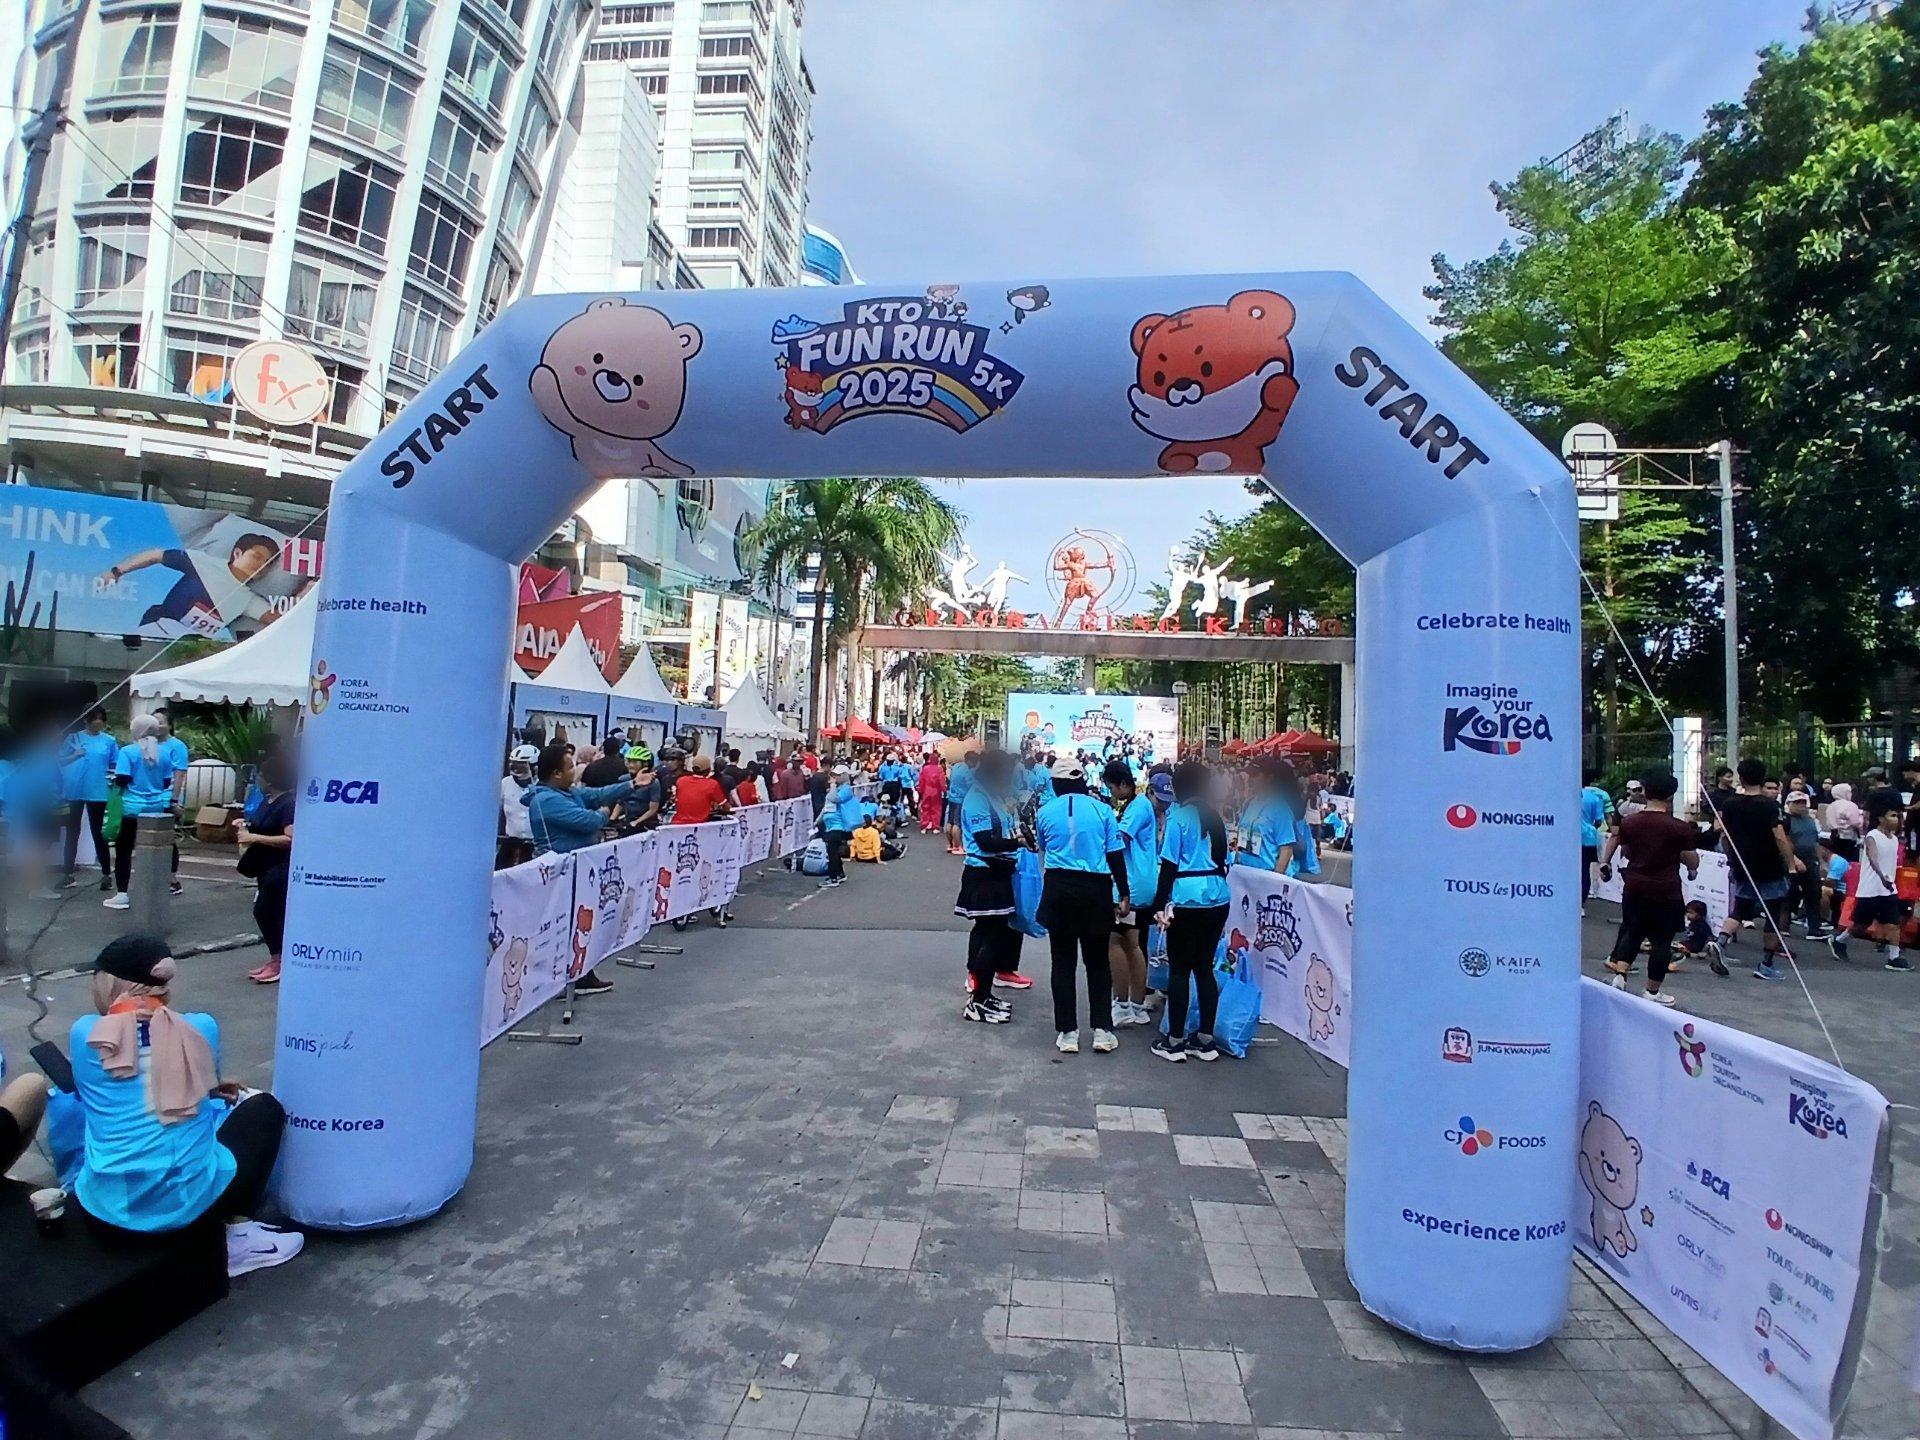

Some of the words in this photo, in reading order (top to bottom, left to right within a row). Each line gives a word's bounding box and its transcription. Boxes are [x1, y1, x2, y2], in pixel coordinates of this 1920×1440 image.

[857, 302, 922, 324] KTO
[798, 325, 884, 372] FUN
[892, 324, 975, 366] RUN
[970, 359, 1012, 399] 5K
[840, 371, 934, 409] 2025
[1334, 346, 1490, 480] START
[381, 364, 501, 489] START
[370, 598, 428, 615] health
[1416, 613, 1520, 631] Celebrate
[1524, 613, 1572, 634] health
[341, 679, 369, 687] KOREA
[1446, 683, 1518, 700] Imagine
[340, 690, 378, 700] TOURISM
[338, 702, 410, 714] ORGANIZATION
[1492, 700, 1534, 714] your
[1443, 705, 1553, 754] Korea
[324, 779, 379, 804] BCA
[1482, 812, 1554, 826] NONGSHIM
[1444, 878, 1490, 894] TOUS
[1493, 882, 1509, 895] les
[1510, 883, 1554, 899] JOURS
[292, 943, 324, 960] ORLY
[1496, 956, 1541, 968] KAIFA
[1478, 1045, 1502, 1054] JUNG
[1789, 1075, 1828, 1099] Imagine
[1813, 1096, 1836, 1112] your
[285, 1112, 327, 1131] rience
[332, 1118, 385, 1131] Korea
[1789, 1093, 1849, 1140] Korea
[1444, 1129, 1463, 1145] CJ
[1498, 1136, 1547, 1149] FOODS
[1700, 1168, 1731, 1201] BCA
[1402, 1208, 1521, 1242] experience
[1525, 1220, 1567, 1242] Korea
[1677, 1234, 1705, 1258] ORLY
[1785, 1223, 1833, 1259] NONGSHIM
